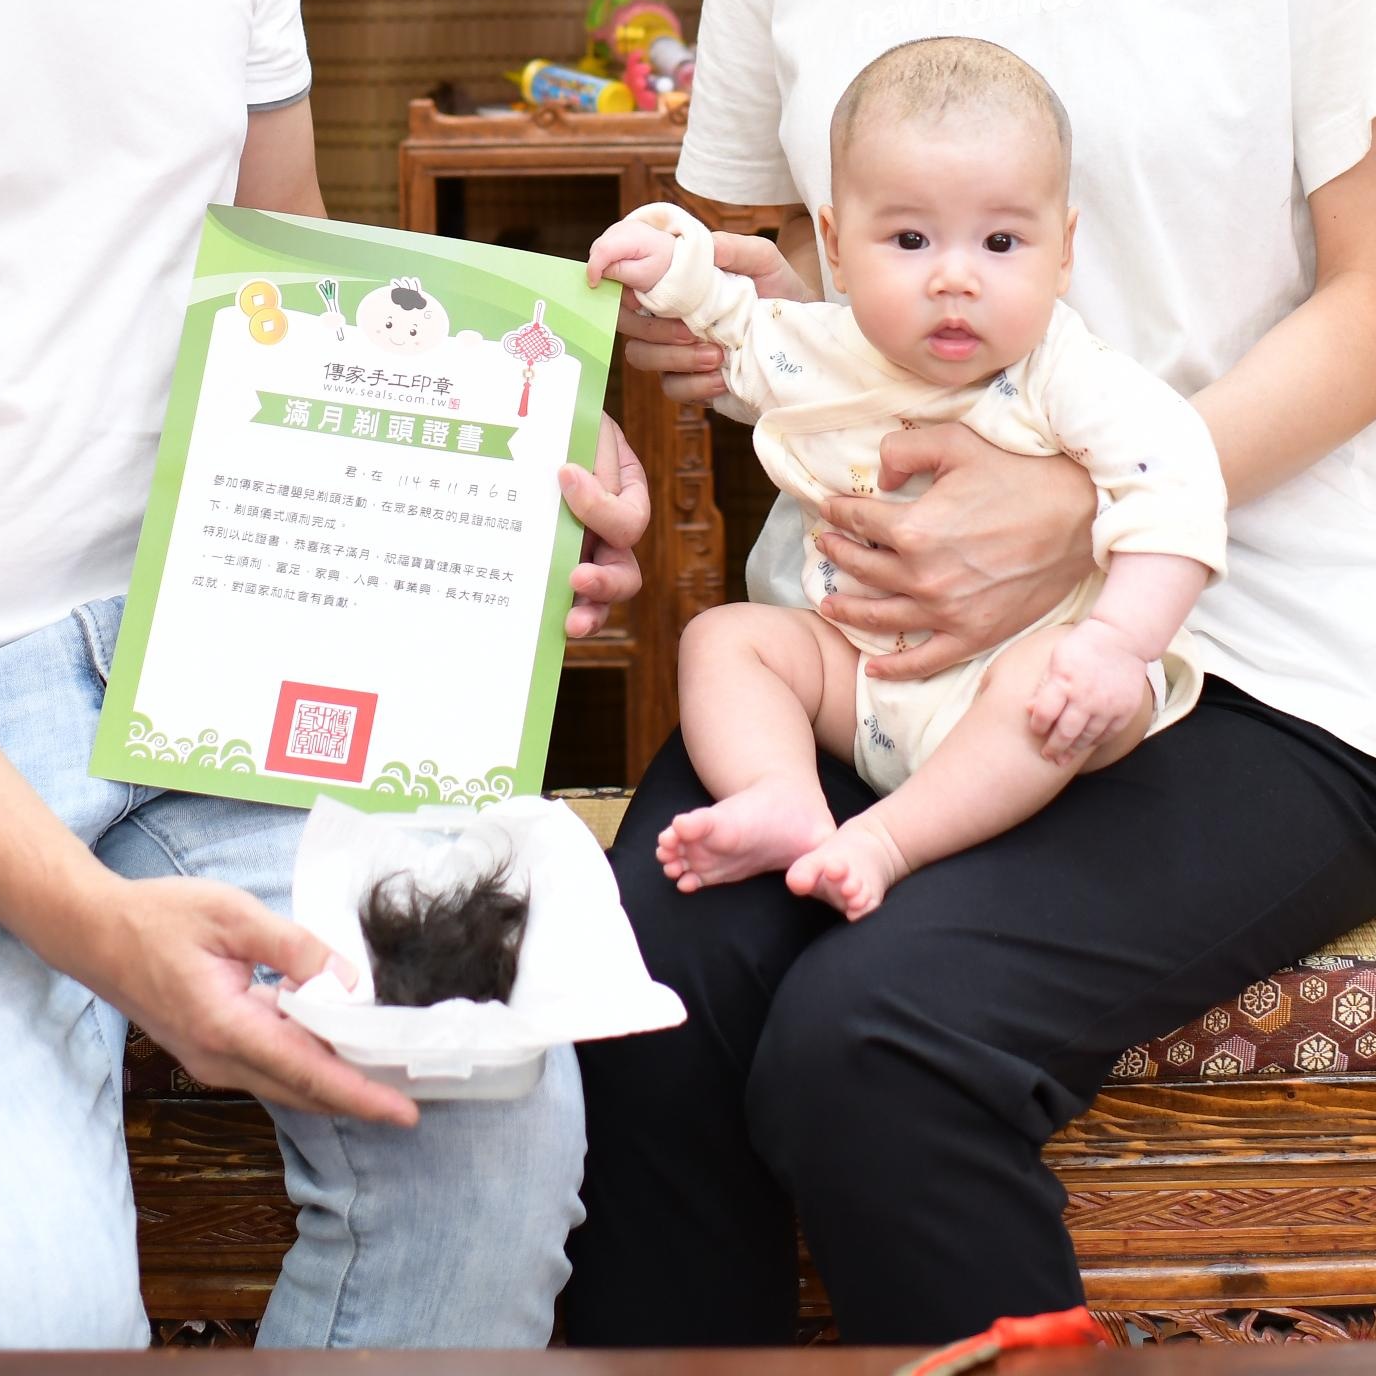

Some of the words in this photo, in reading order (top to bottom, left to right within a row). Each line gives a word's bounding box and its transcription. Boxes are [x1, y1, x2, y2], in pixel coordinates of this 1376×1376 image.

[323, 361, 454, 396] 傳家手工印章
[323, 383, 448, 407] www.seals.com.tw
[282, 398, 484, 452] 滿月剃頭證書
[428, 478, 441, 491] 年
[466, 484, 479, 497] 月
[506, 489, 518, 502] 日
